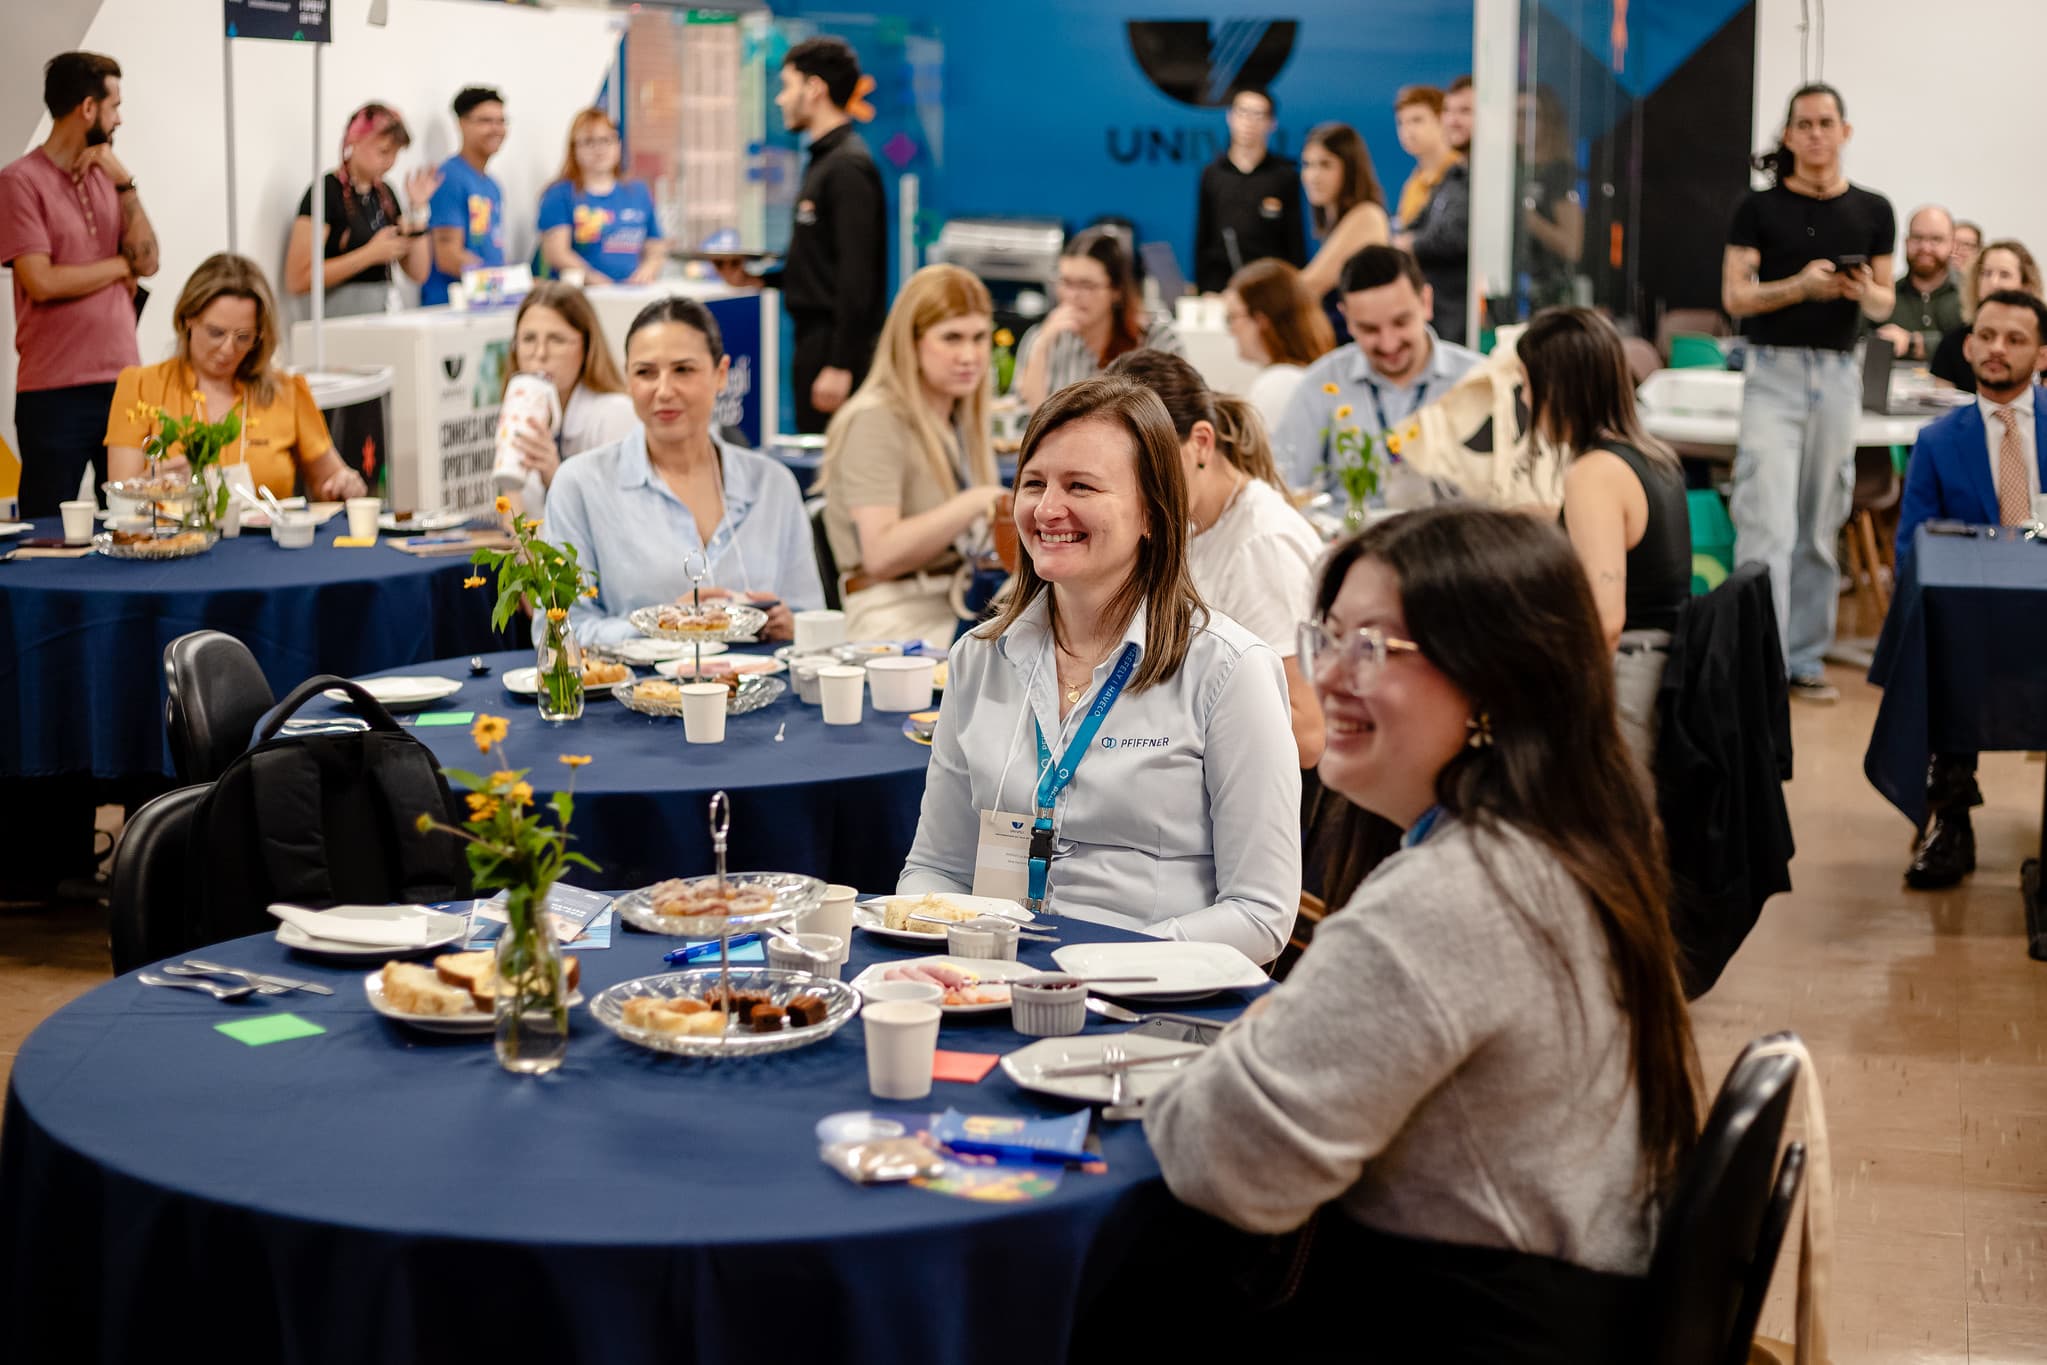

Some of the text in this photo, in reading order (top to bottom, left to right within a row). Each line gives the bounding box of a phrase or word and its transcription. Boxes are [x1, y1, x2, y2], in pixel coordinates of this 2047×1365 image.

[1106, 127, 1297, 164] UNIVL
[1094, 684, 1116, 718] HAVECO
[1120, 737, 1169, 748] PFIFFNER
